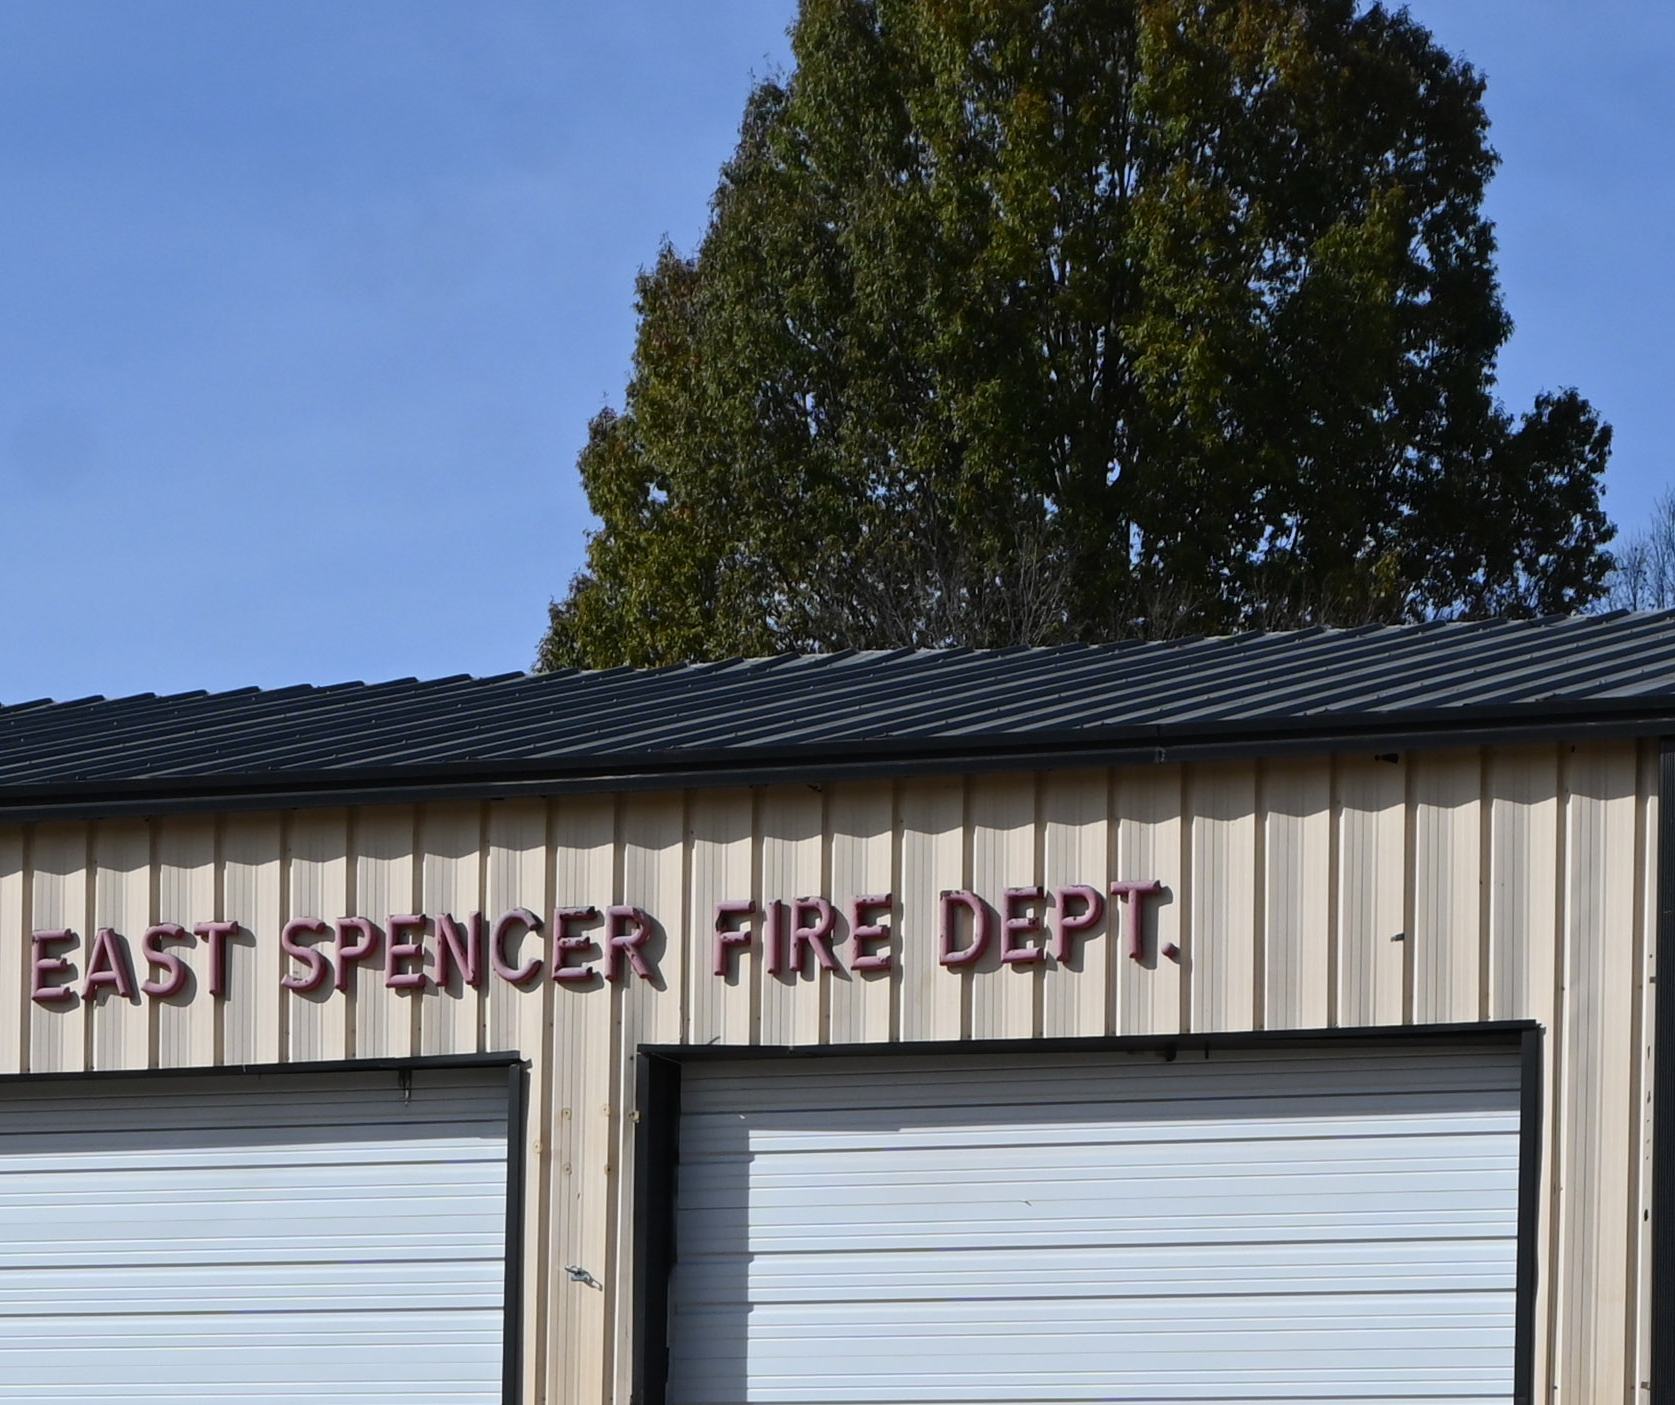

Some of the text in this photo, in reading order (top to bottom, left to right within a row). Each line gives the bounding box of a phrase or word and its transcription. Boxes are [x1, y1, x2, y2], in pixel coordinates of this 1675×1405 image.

[31, 879, 1178, 1001] EAST SPENCER FIRE DEPT.
